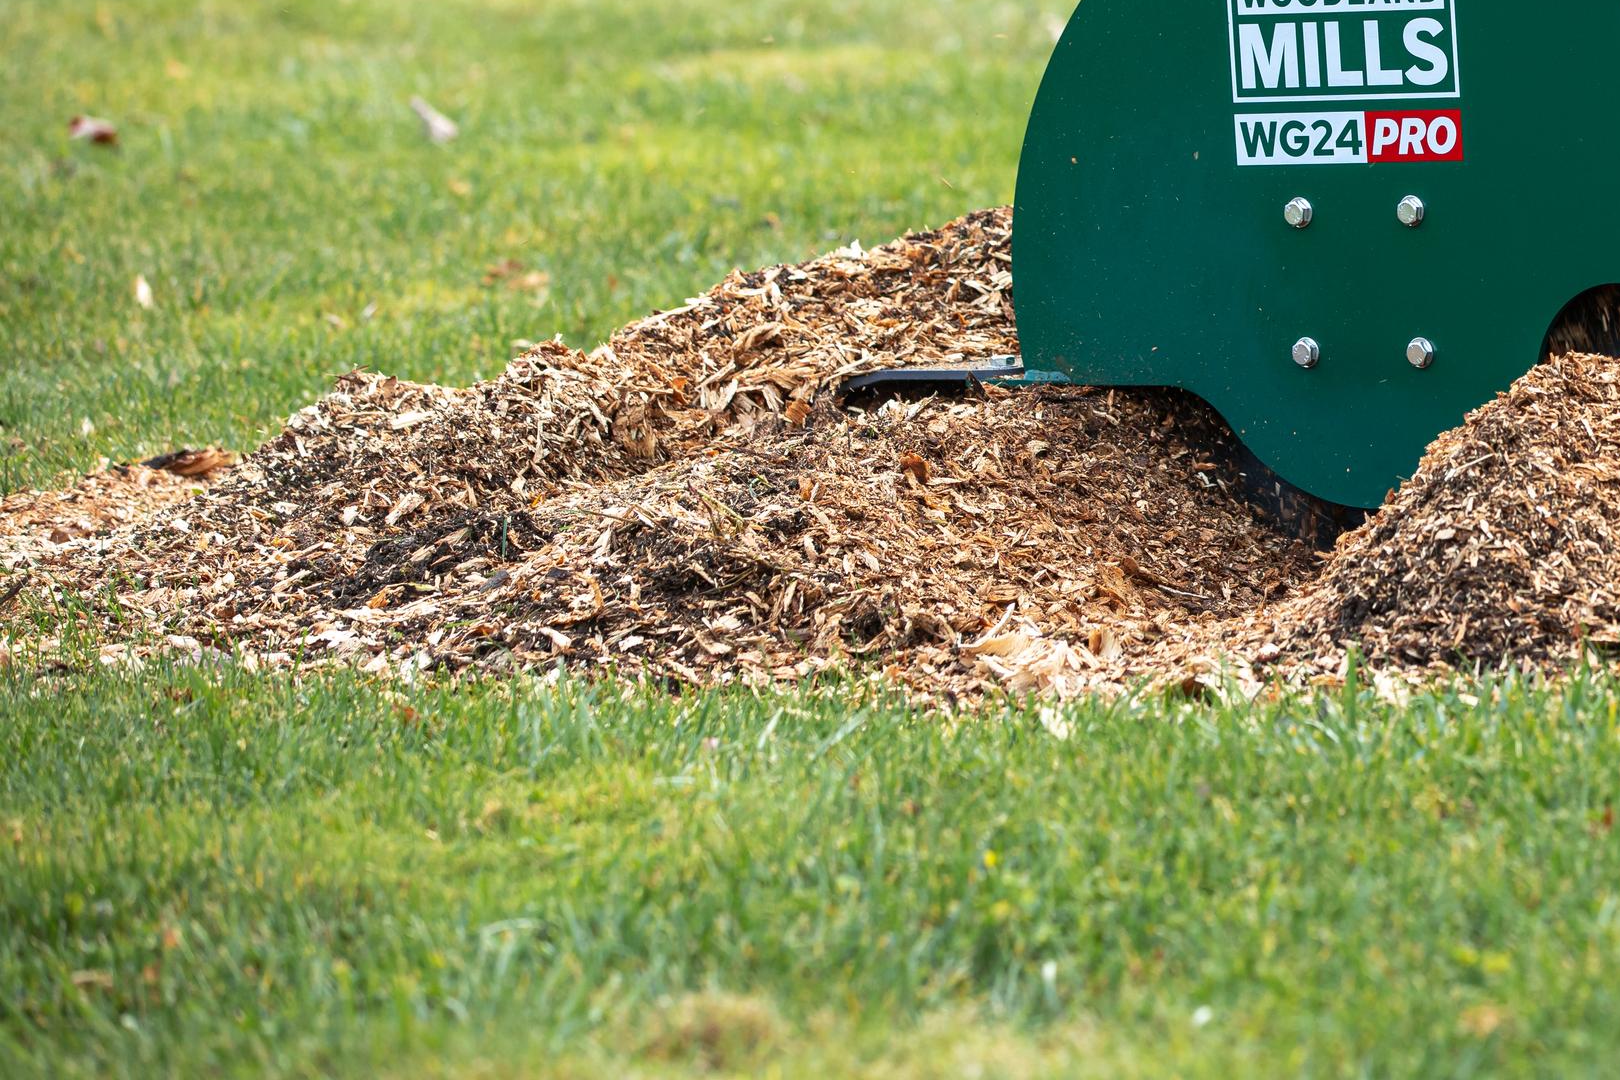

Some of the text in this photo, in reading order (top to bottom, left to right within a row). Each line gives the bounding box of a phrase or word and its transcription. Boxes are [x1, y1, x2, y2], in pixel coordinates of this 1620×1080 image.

[1238, 17, 1449, 89] MILLS
[1240, 116, 1457, 158] WG24 PRO
